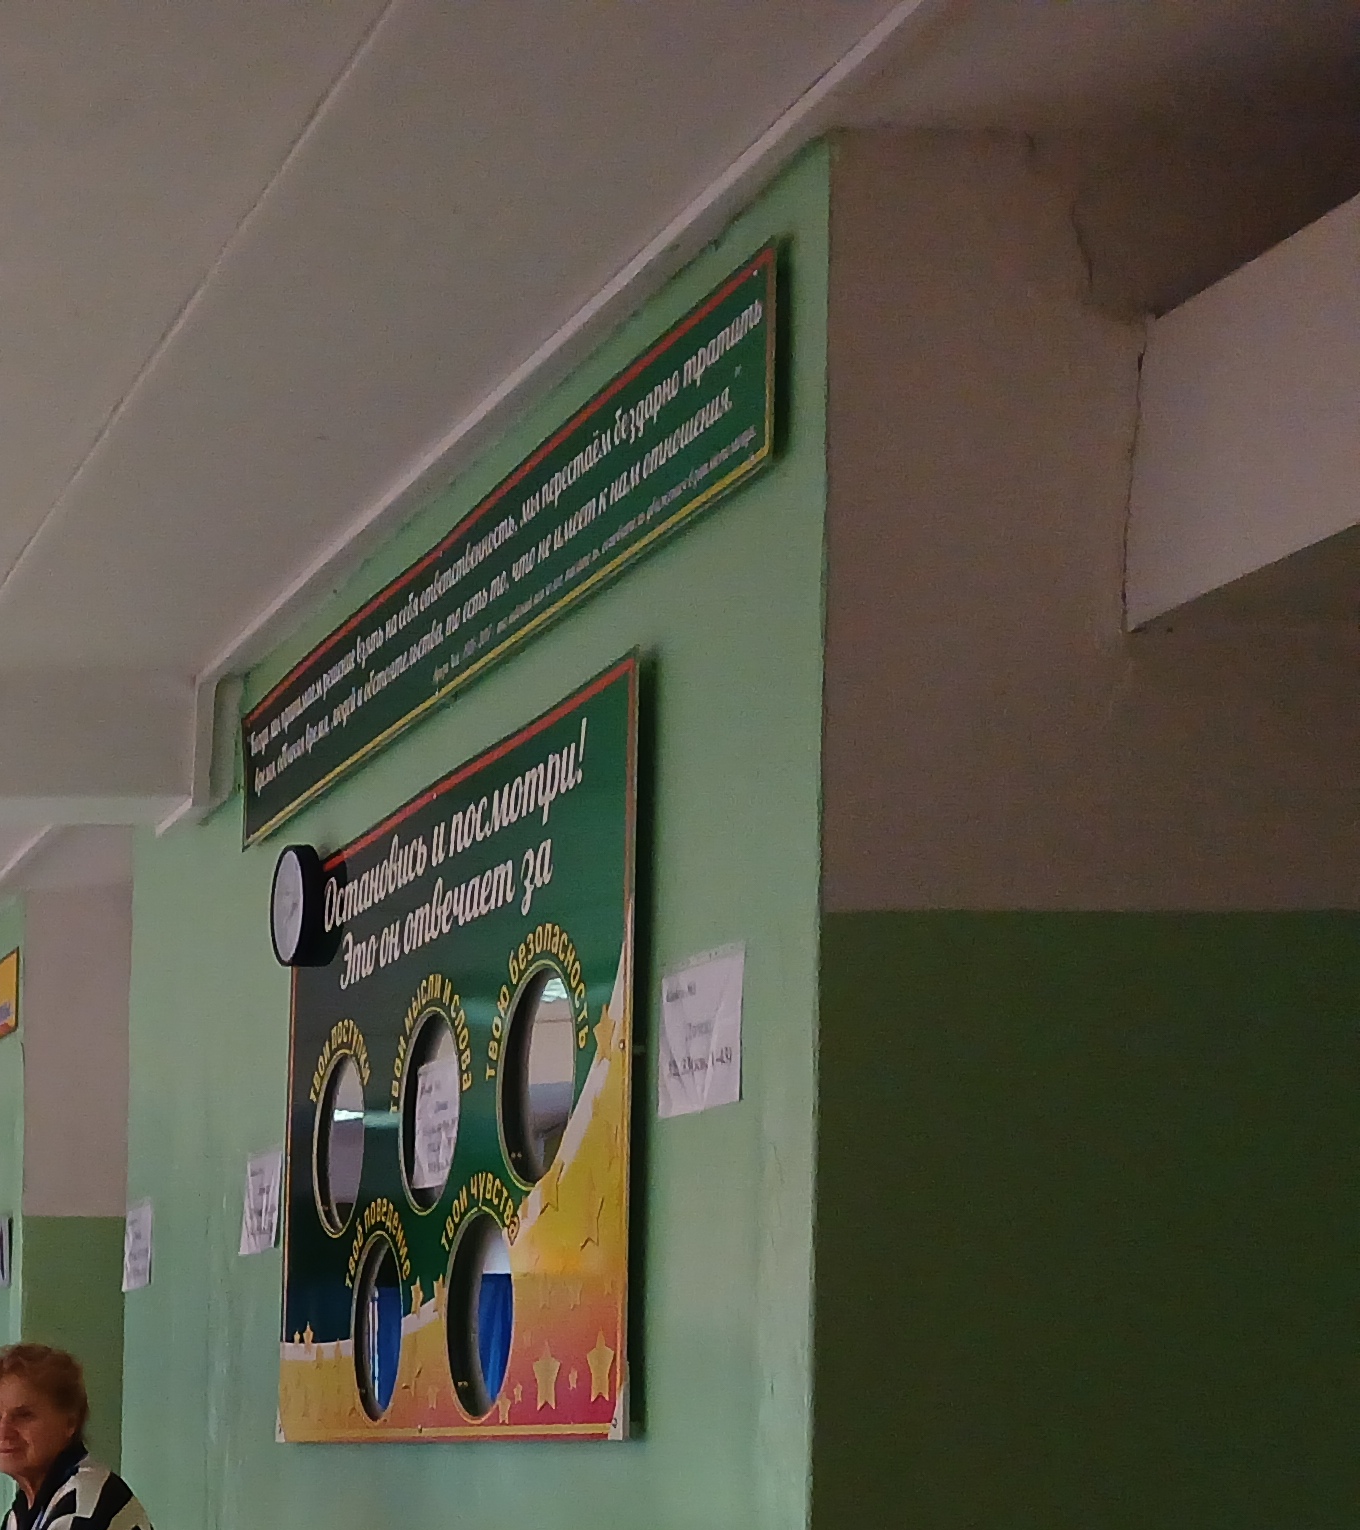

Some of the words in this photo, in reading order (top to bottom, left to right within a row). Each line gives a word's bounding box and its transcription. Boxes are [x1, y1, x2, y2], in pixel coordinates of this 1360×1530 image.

[356, 627, 384, 669] взять
[385, 614, 398, 642] на
[398, 592, 419, 630] себя
[419, 514, 518, 612] ответственность,
[520, 490, 540, 528] мы
[541, 430, 612, 508] перестаём
[613, 371, 680, 445] бездарно
[682, 299, 762, 388] тратить
[445, 607, 461, 637] то
[462, 587, 488, 623] есть
[511, 547, 536, 582] что
[537, 533, 552, 563] не
[553, 497, 597, 551] имеет
[598, 487, 609, 516] к
[609, 460, 641, 506] нам
[324, 833, 428, 933] Остановись
[431, 820, 447, 867] и
[448, 717, 587, 858] посмотри!
[340, 931, 378, 990] Это
[379, 919, 401, 969] он
[403, 859, 516, 955] отвечает
[520, 838, 553, 916] за
[309, 1039, 331, 1103] твои
[331, 1018, 371, 1087] поступки
[389, 1035, 407, 1114] твои
[404, 973, 442, 1036] мысли
[442, 978, 452, 1007] и
[450, 994, 473, 1092] слова
[485, 984, 510, 1082] твою
[508, 922, 589, 1049] безопасность
[363, 1197, 411, 1281] поведение
[440, 1184, 468, 1252] твои
[470, 1170, 520, 1247] чувства
